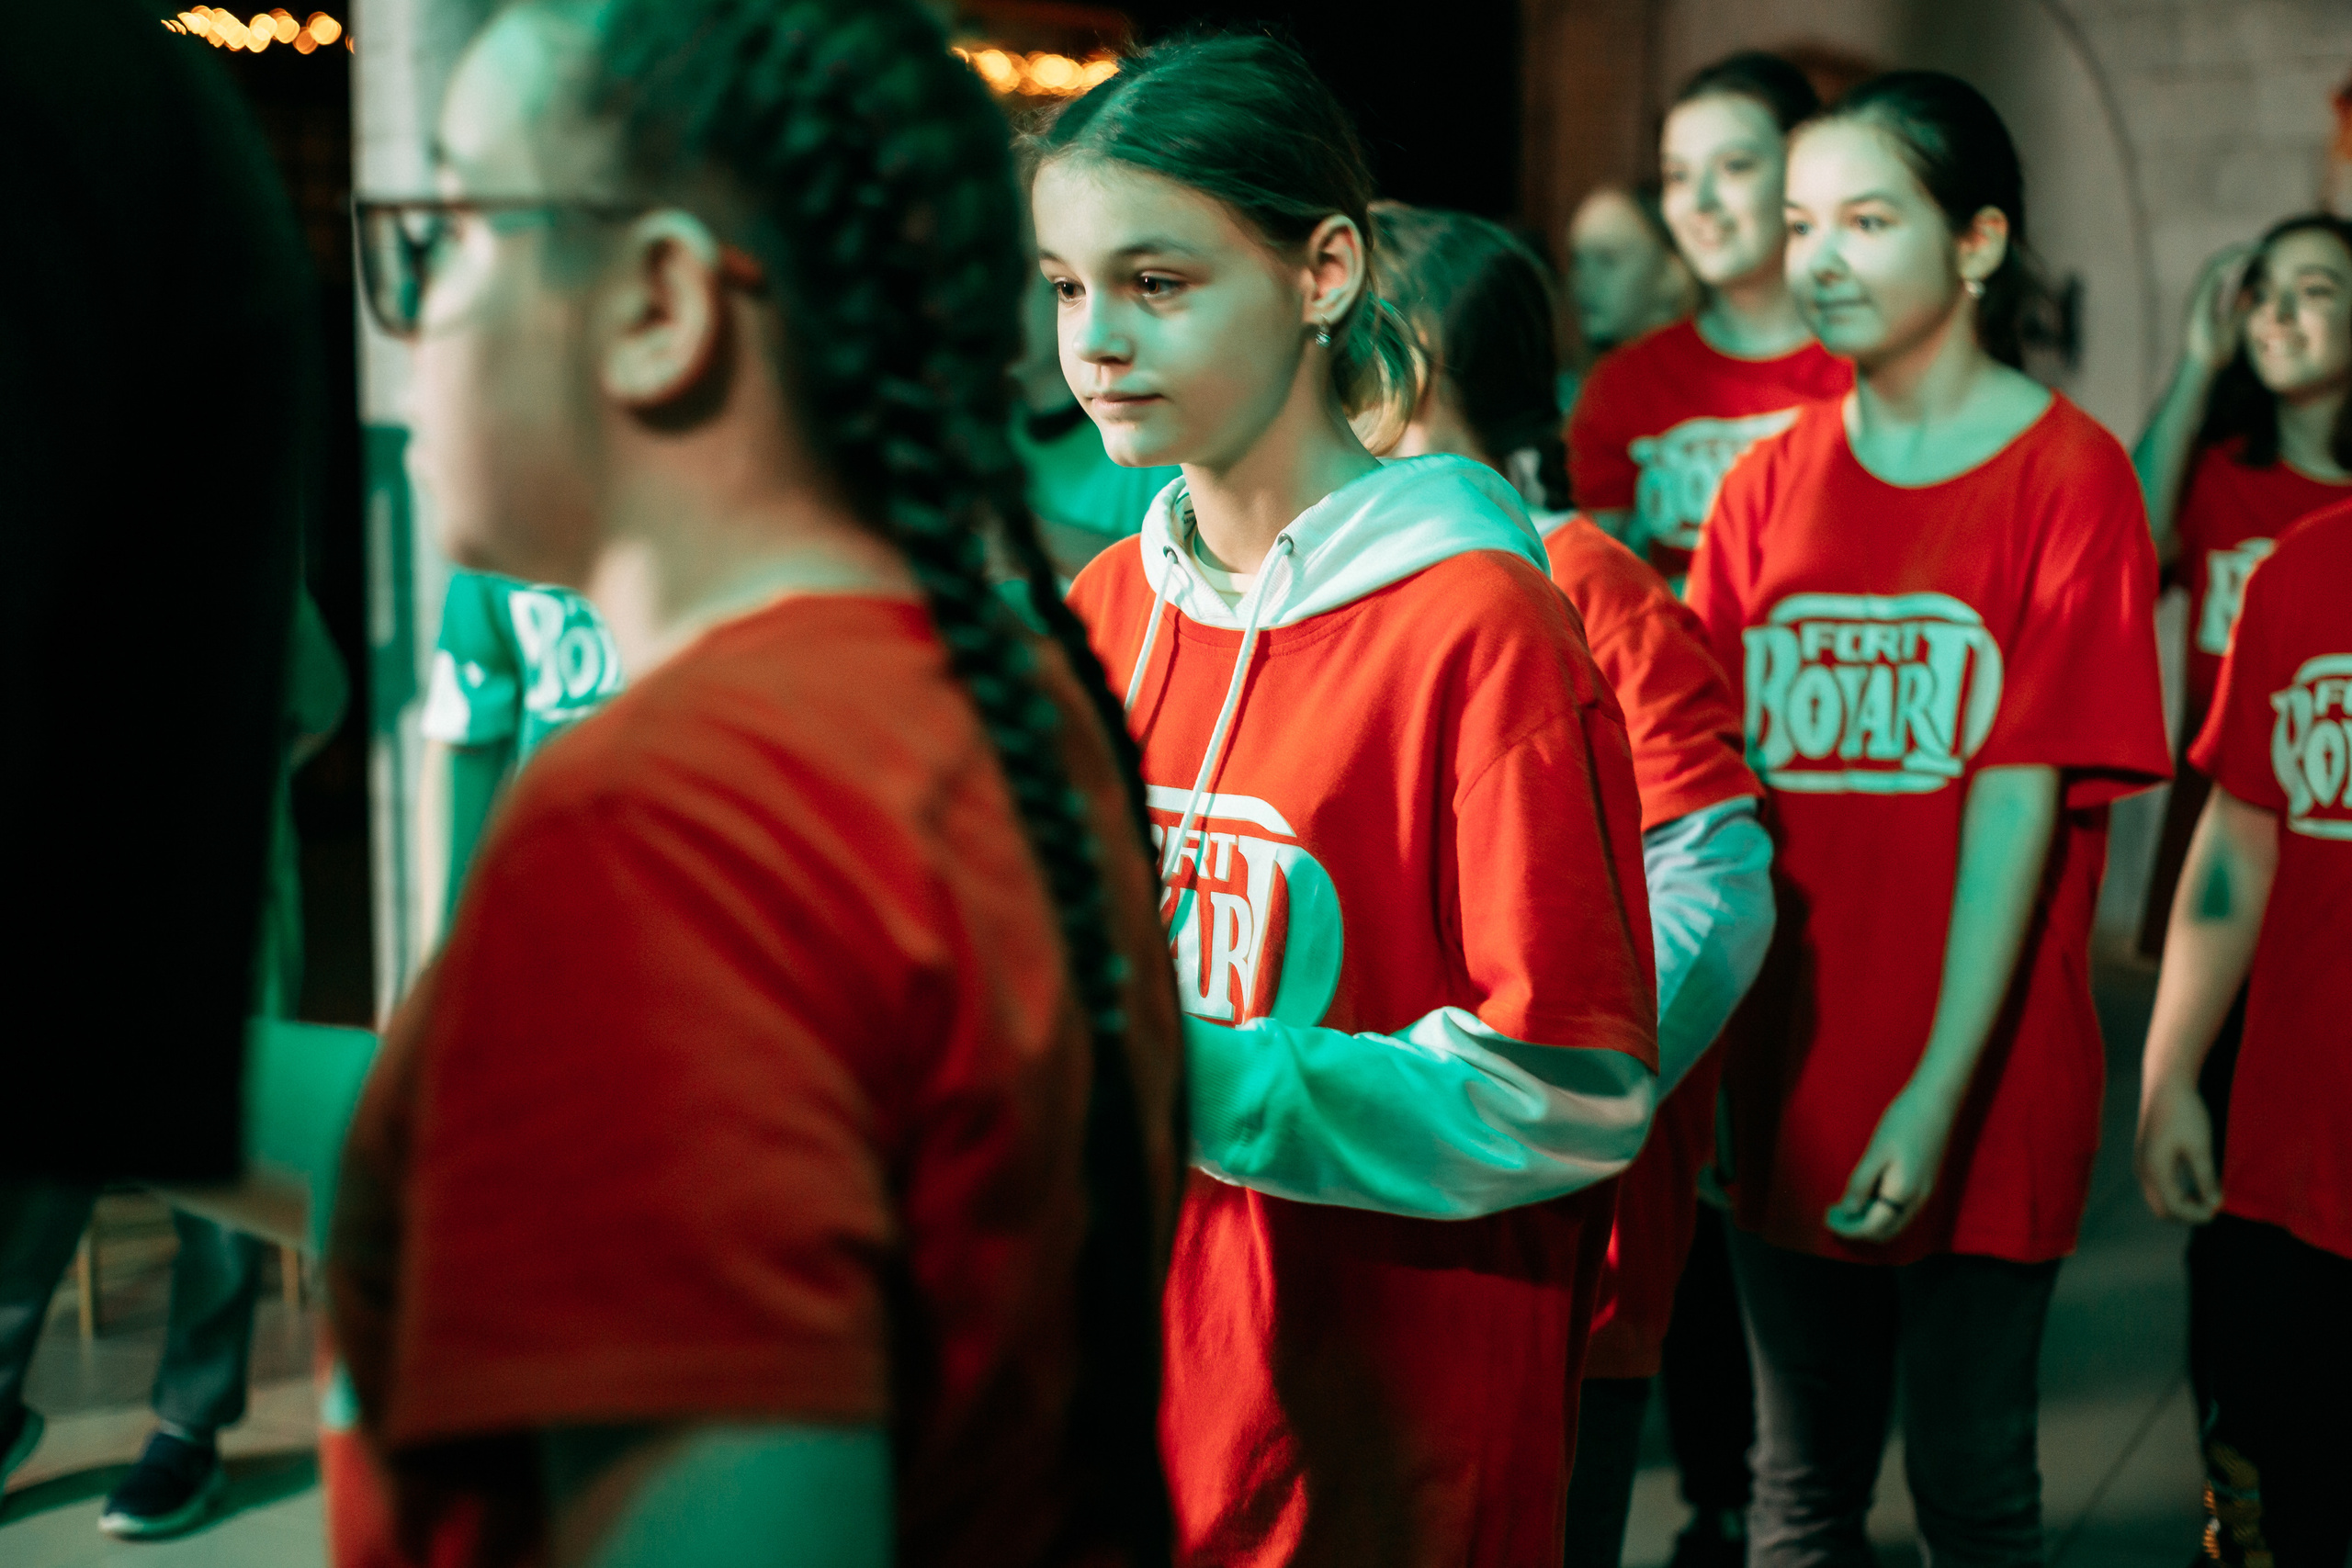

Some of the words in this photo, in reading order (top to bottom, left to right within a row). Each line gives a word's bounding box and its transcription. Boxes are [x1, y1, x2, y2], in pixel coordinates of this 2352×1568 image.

[1801, 622, 1923, 663] FORT
[1742, 622, 2004, 777] BOYARD
[1150, 824, 1238, 882] RT
[1159, 835, 1344, 1029] ARD
